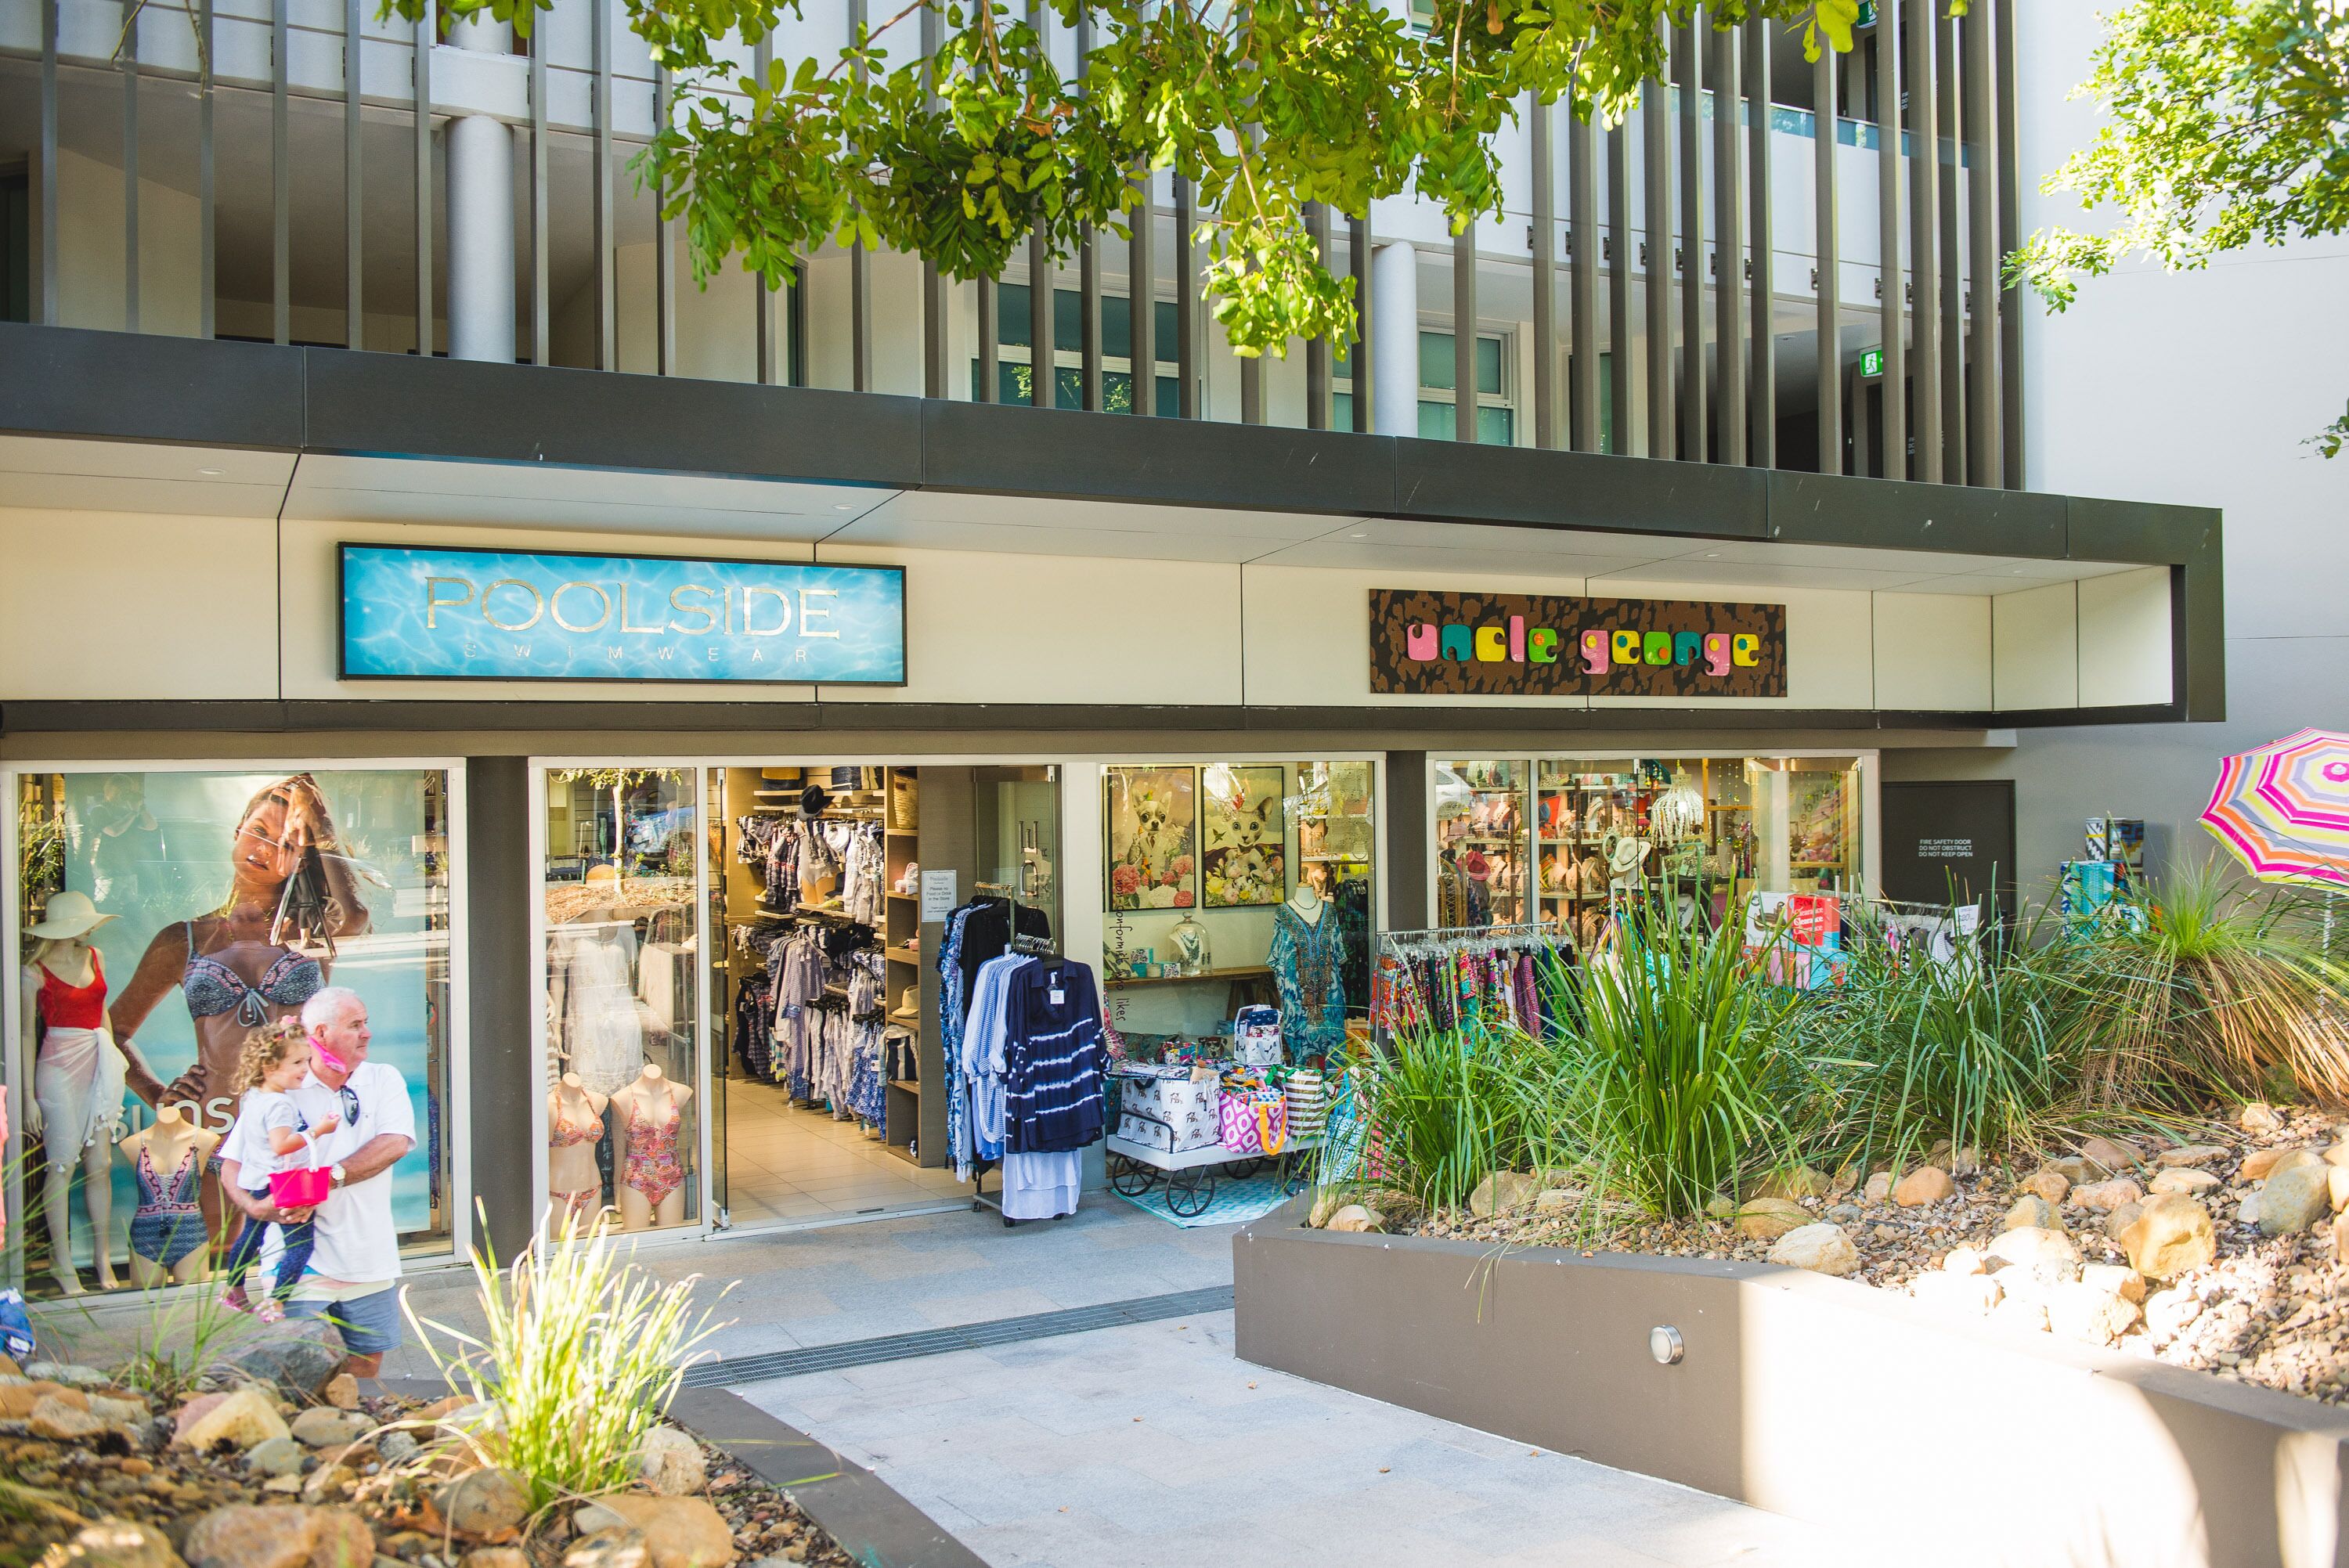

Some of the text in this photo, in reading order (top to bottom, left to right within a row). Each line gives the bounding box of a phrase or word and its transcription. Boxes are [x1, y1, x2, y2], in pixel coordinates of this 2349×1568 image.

[425, 576, 841, 640] POOLSIDE
[463, 643, 808, 665] SWIMWEAR
[1407, 615, 1760, 676] uncle george
[1109, 879, 1133, 967] non-conformist
[1795, 907, 1824, 916] Cearace
[1115, 998, 1130, 1021] likes
